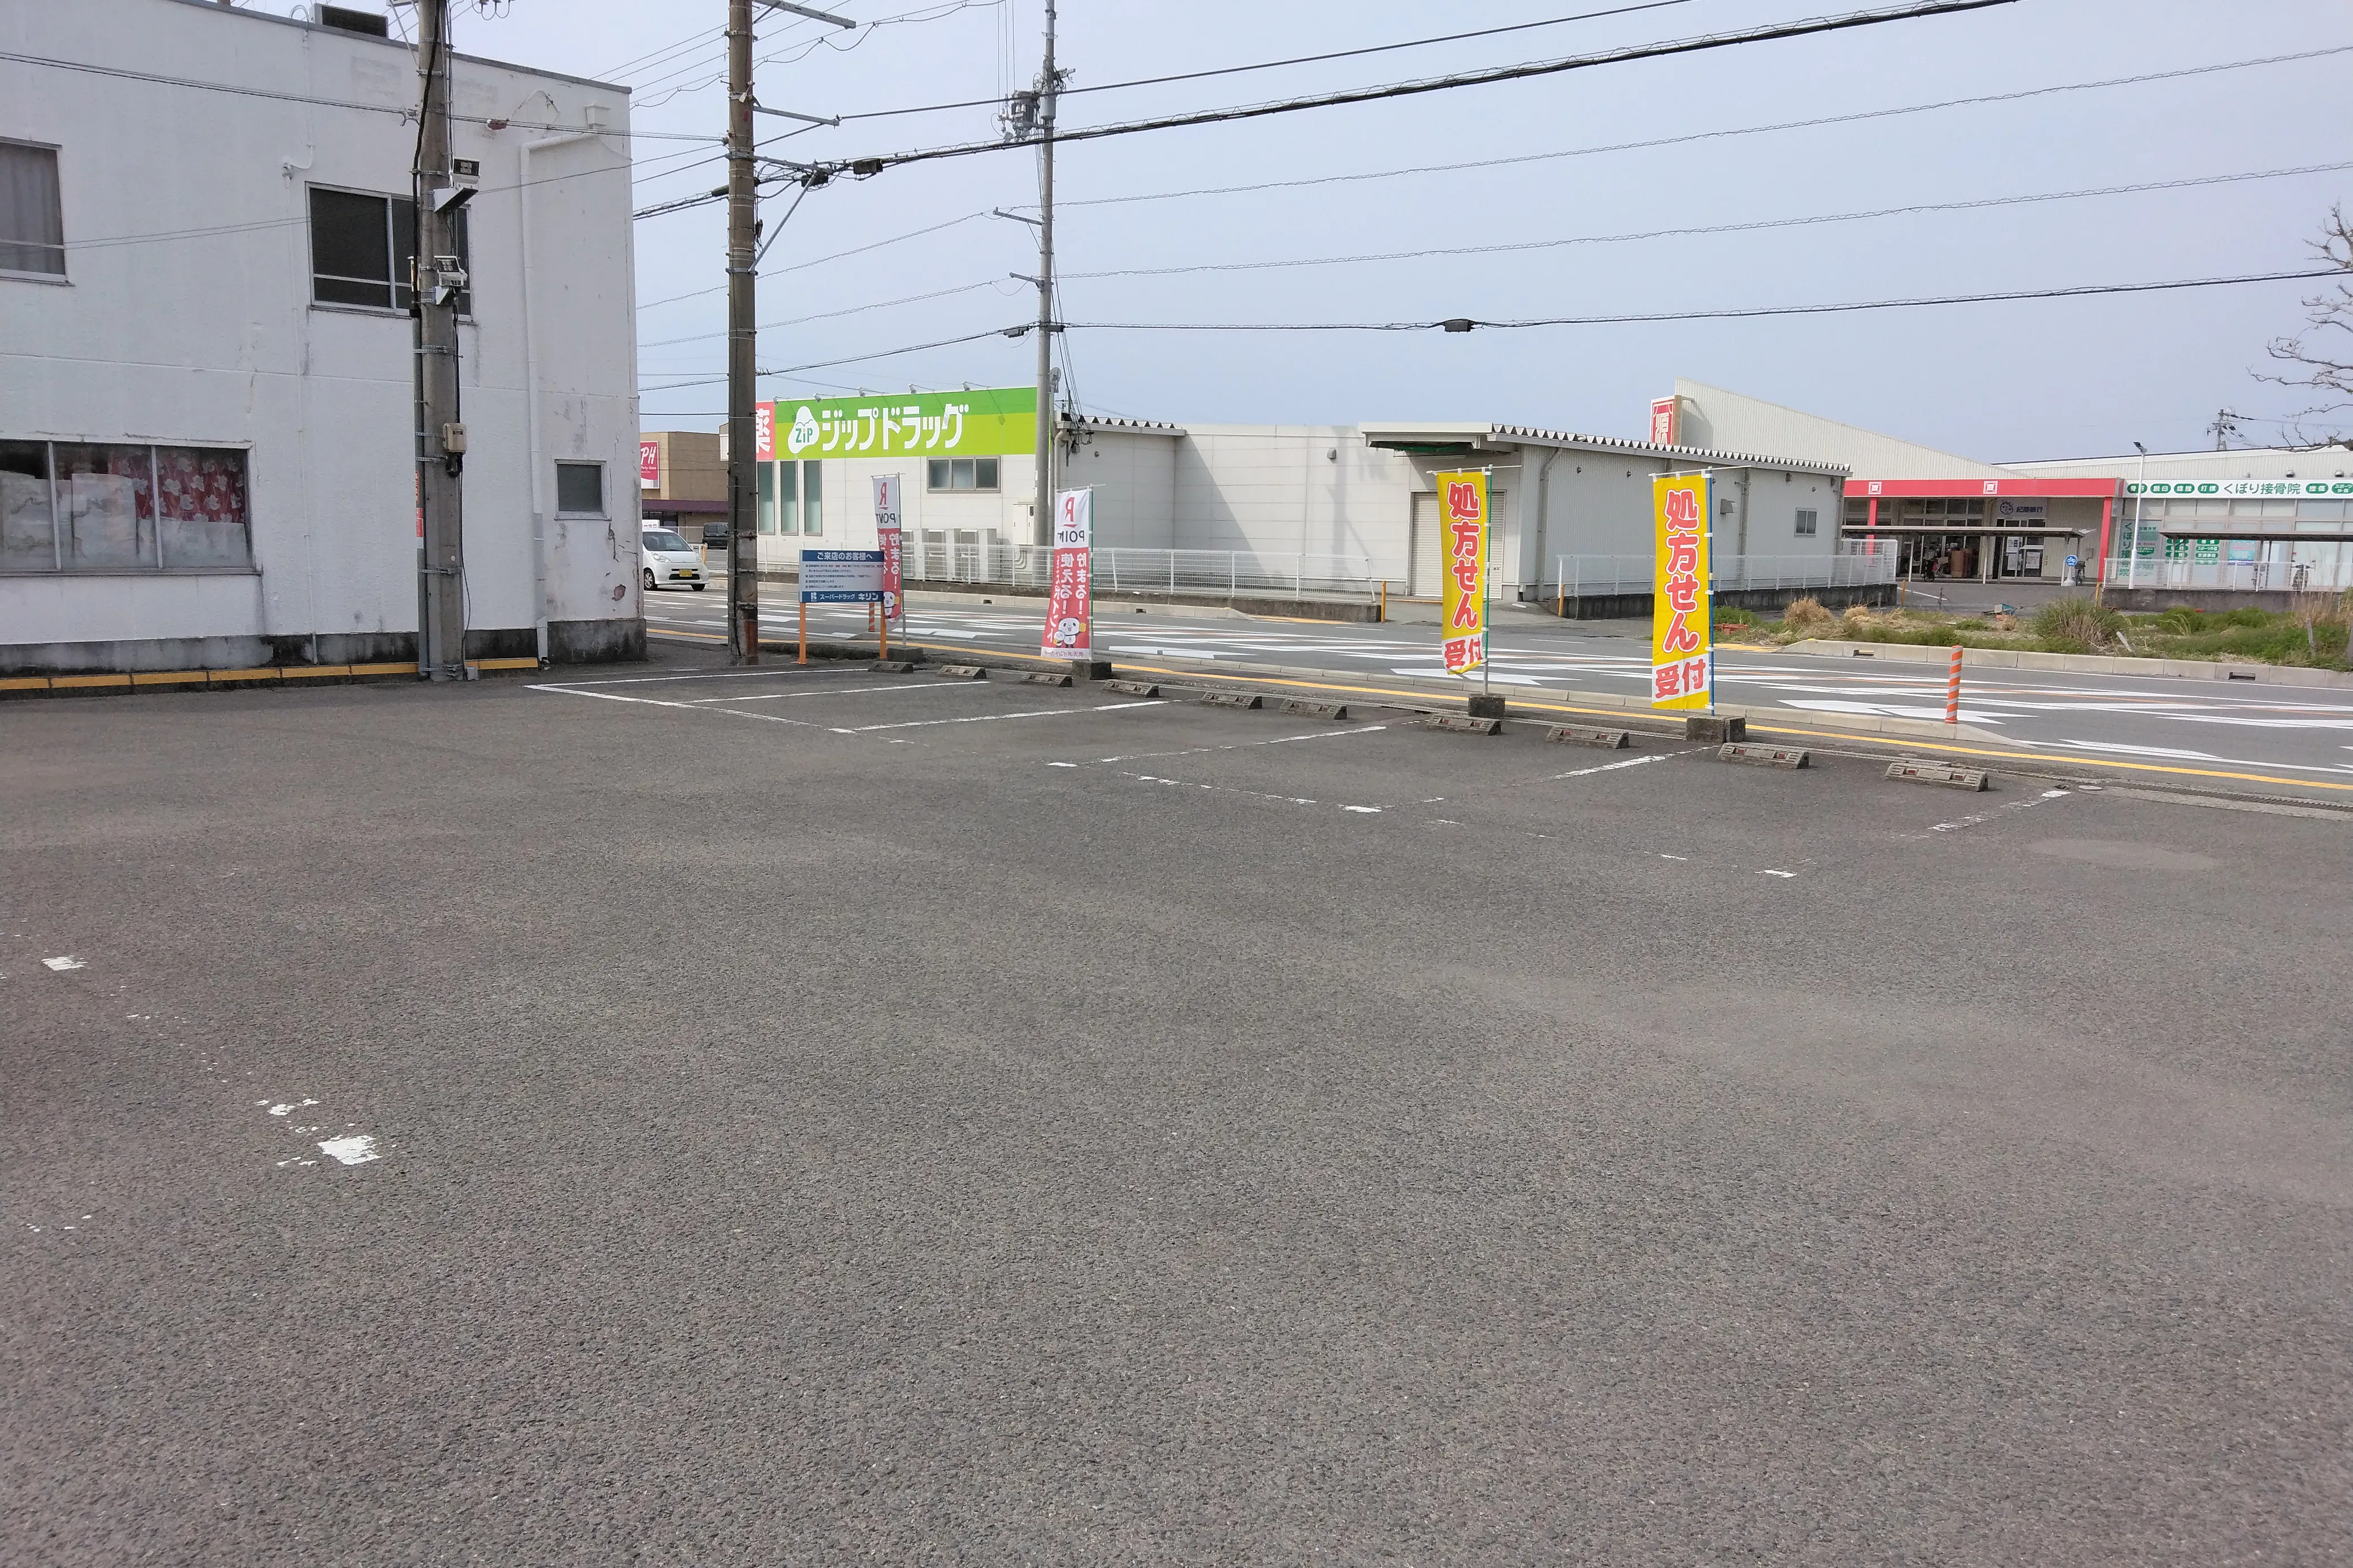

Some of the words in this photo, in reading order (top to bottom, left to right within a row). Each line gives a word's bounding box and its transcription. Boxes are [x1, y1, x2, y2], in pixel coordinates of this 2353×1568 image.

[821, 403, 969, 451] ジップドラッグ
[640, 446, 656, 465] PH
[817, 552, 873, 560] ご来店のお客様へ
[1446, 481, 1481, 630] 処方せん
[1662, 488, 1701, 654] 処方せん
[1654, 658, 1706, 699] 受付
